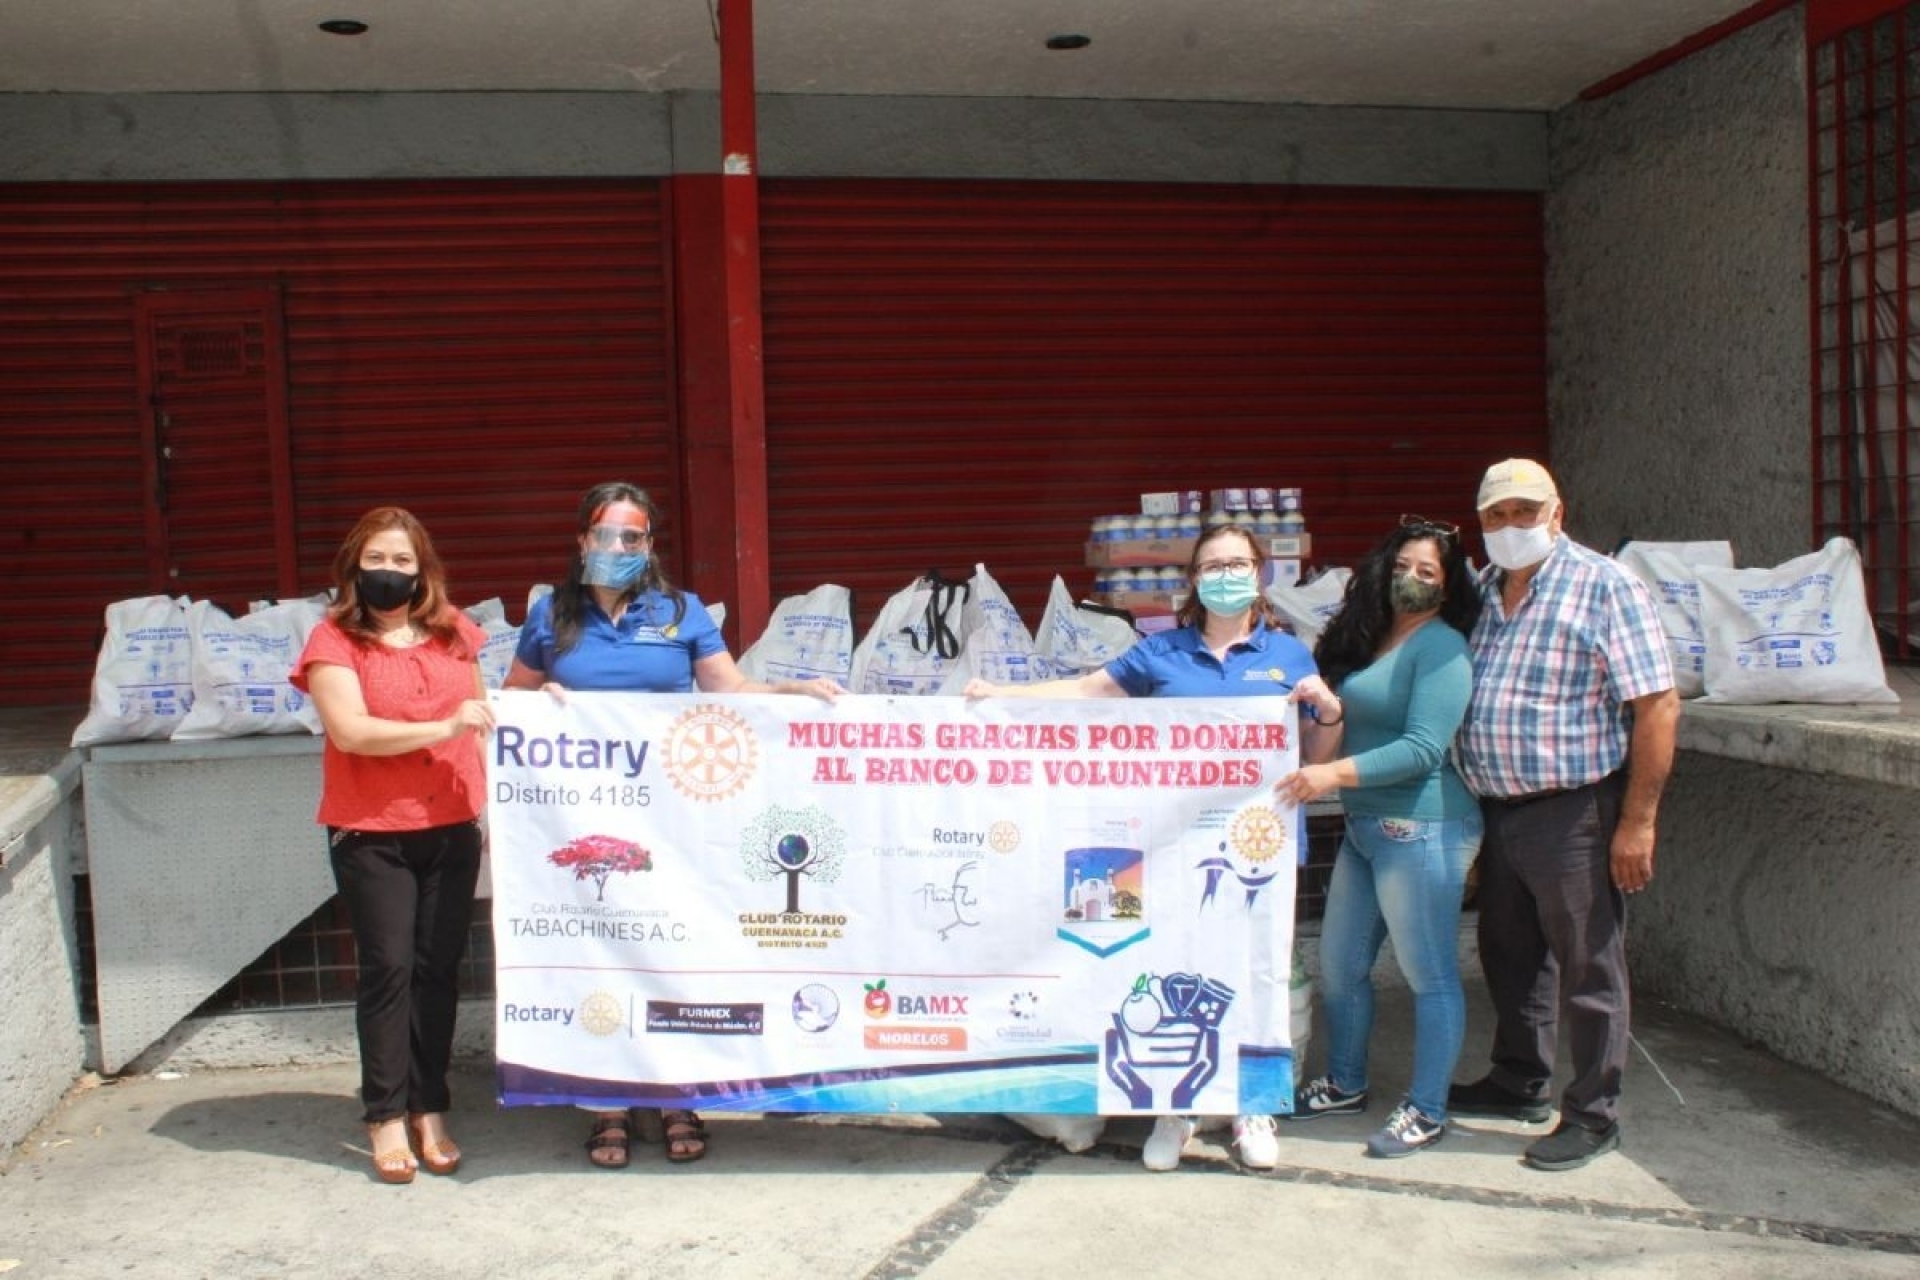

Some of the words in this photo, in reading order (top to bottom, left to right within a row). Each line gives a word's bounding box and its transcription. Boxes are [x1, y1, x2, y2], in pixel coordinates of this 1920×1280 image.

[788, 722, 924, 749] MUCHAS
[935, 723, 1078, 750] GRACIAS
[1087, 723, 1157, 750] POR
[1168, 724, 1288, 751] DONAR
[496, 725, 649, 778] Rotary
[812, 756, 856, 783] AL
[864, 757, 977, 785] BANCO
[987, 758, 1033, 786] DE
[1043, 758, 1262, 788] VOLUNTADES
[496, 782, 580, 806] Distrito
[589, 783, 651, 807] 4185
[933, 827, 985, 847] Rotary
[508, 918, 645, 942] TABACHINES
[648, 920, 693, 943] A.C.
[738, 913, 777, 924] CLUB
[782, 914, 847, 926] ROTARIO
[504, 1003, 575, 1027] Rotary
[678, 1007, 731, 1018] FURMEX
[897, 995, 969, 1015] BAMX
[878, 1032, 949, 1046] MORELOS
